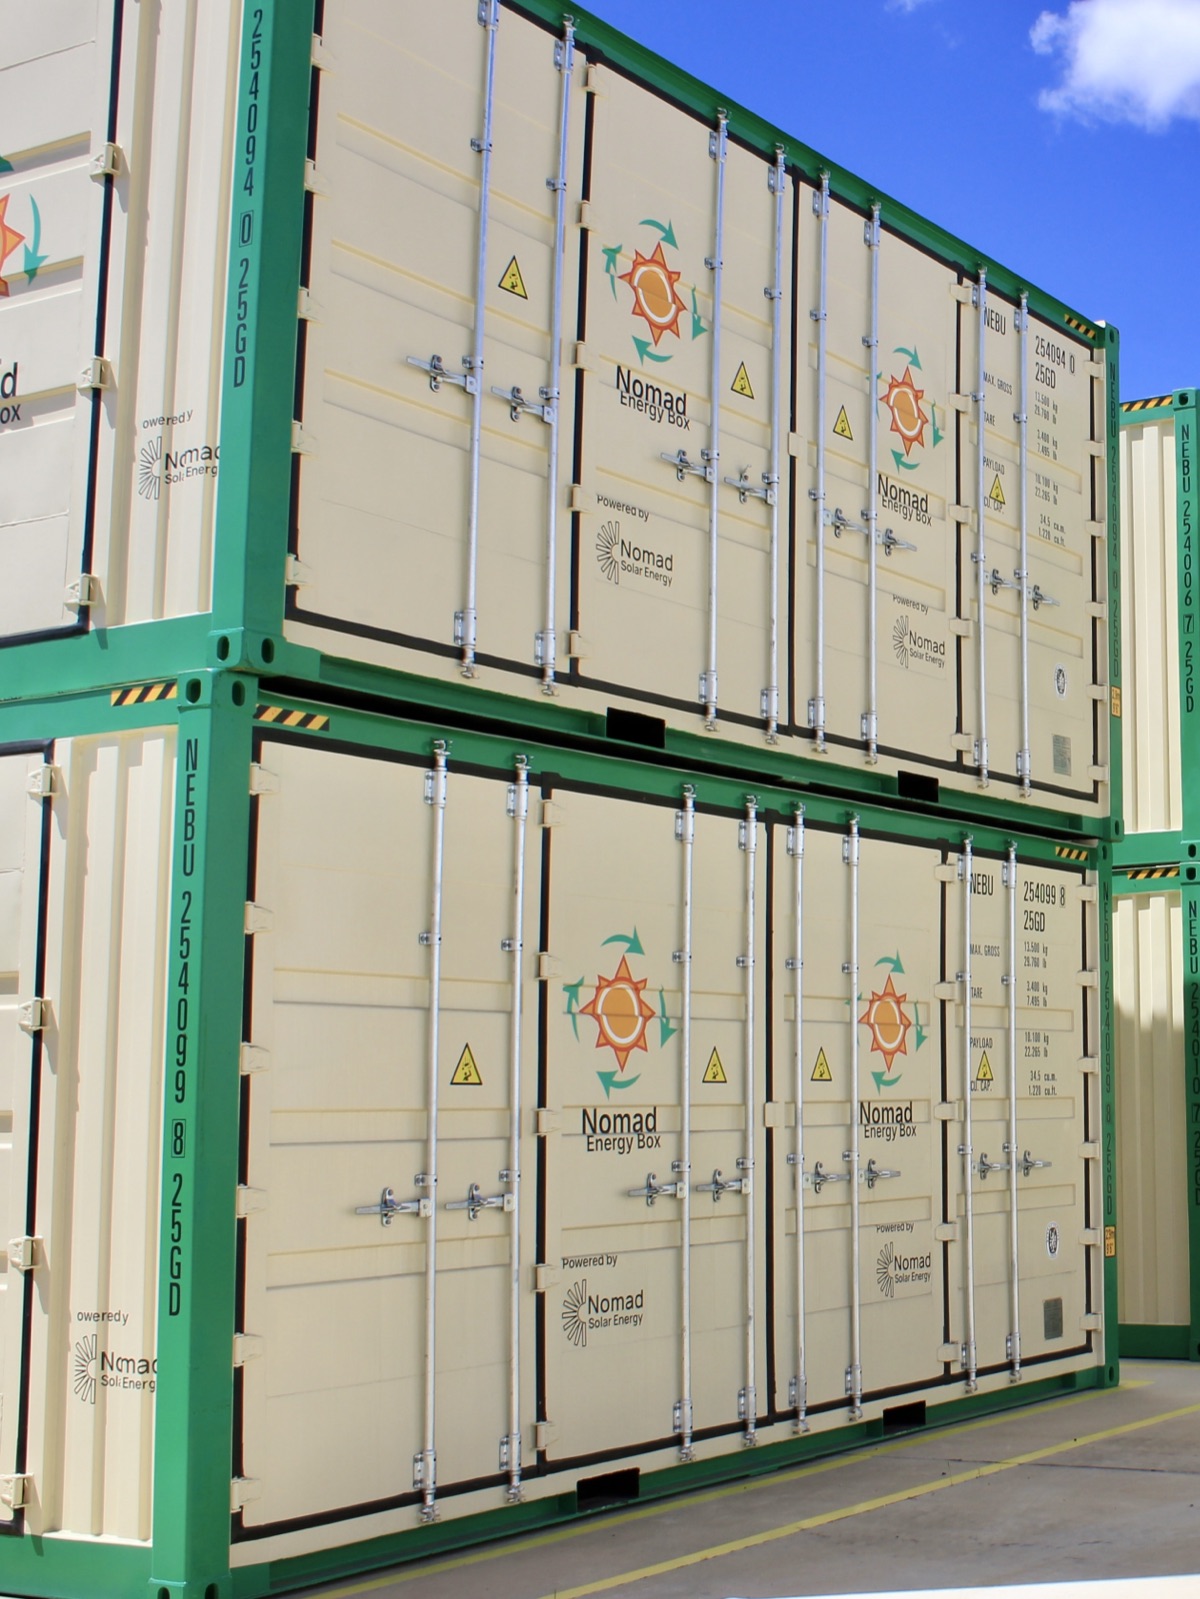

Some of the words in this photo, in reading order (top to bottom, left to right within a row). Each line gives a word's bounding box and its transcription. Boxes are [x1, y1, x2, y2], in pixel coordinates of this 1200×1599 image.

[243, 8, 263, 197] 254094
[240, 212, 253, 245] 0
[233, 258, 249, 388] 25GD
[984, 306, 1006, 335] NEBU
[1035, 335, 1066, 369] 254094
[1070, 354, 1075, 374] 0
[1035, 362, 1056, 389] 25GD
[616, 365, 687, 416] Nomad
[0, 404, 21, 425] ox
[142, 412, 185, 429] owered
[620, 391, 664, 423] Energy
[668, 408, 690, 431] Box
[185, 464, 218, 478] Energ
[983, 456, 1005, 475] PAYLOAD
[1181, 425, 1191, 493] NEBU
[878, 474, 929, 513] Nomad
[596, 494, 637, 516] Powered
[638, 509, 650, 522] by
[881, 495, 913, 522] Energy
[916, 509, 932, 527] Box
[620, 539, 673, 571] Nomad
[1182, 500, 1193, 606] 254006
[620, 560, 643, 576] Solar
[644, 567, 673, 587] Energy
[892, 594, 920, 611] Powered
[1184, 614, 1193, 633] 7
[909, 630, 945, 655] Nomad
[909, 647, 924, 661] Solar
[925, 653, 945, 669] Energy
[1185, 641, 1194, 713] 25GD
[182, 738, 198, 877] NEBU
[970, 873, 994, 896] NEBU
[1023, 881, 1056, 905] 254099
[1060, 886, 1065, 906] 8
[1024, 910, 1045, 932] 25GD
[1189, 901, 1198, 974] NEBU
[984, 945, 1000, 957] GROSS
[175, 891, 192, 1103] 254099
[971, 987, 983, 999] TARE
[970, 1037, 993, 1049] PAYLOAD
[1190, 983, 1200, 1094] 254010
[582, 1106, 656, 1134] Nomad
[860, 1101, 912, 1124] Nomad
[173, 1120, 185, 1157] 8
[587, 1135, 633, 1154] Energy
[637, 1133, 660, 1149] Box
[864, 1124, 897, 1141] Energy
[900, 1122, 916, 1137] Box
[876, 1223, 905, 1233] Powered
[169, 1173, 182, 1316] 25GD
[562, 1255, 604, 1269] Powered
[606, 1254, 617, 1267] by
[894, 1252, 931, 1271] Nomad
[895, 1273, 910, 1283] Solar
[911, 1271, 930, 1283] Energy
[588, 1289, 643, 1314] Nomad
[77, 1310, 121, 1322] owered
[588, 1317, 611, 1329] Solar
[614, 1313, 643, 1327] Energy
[122, 1376, 155, 1393] Energ
